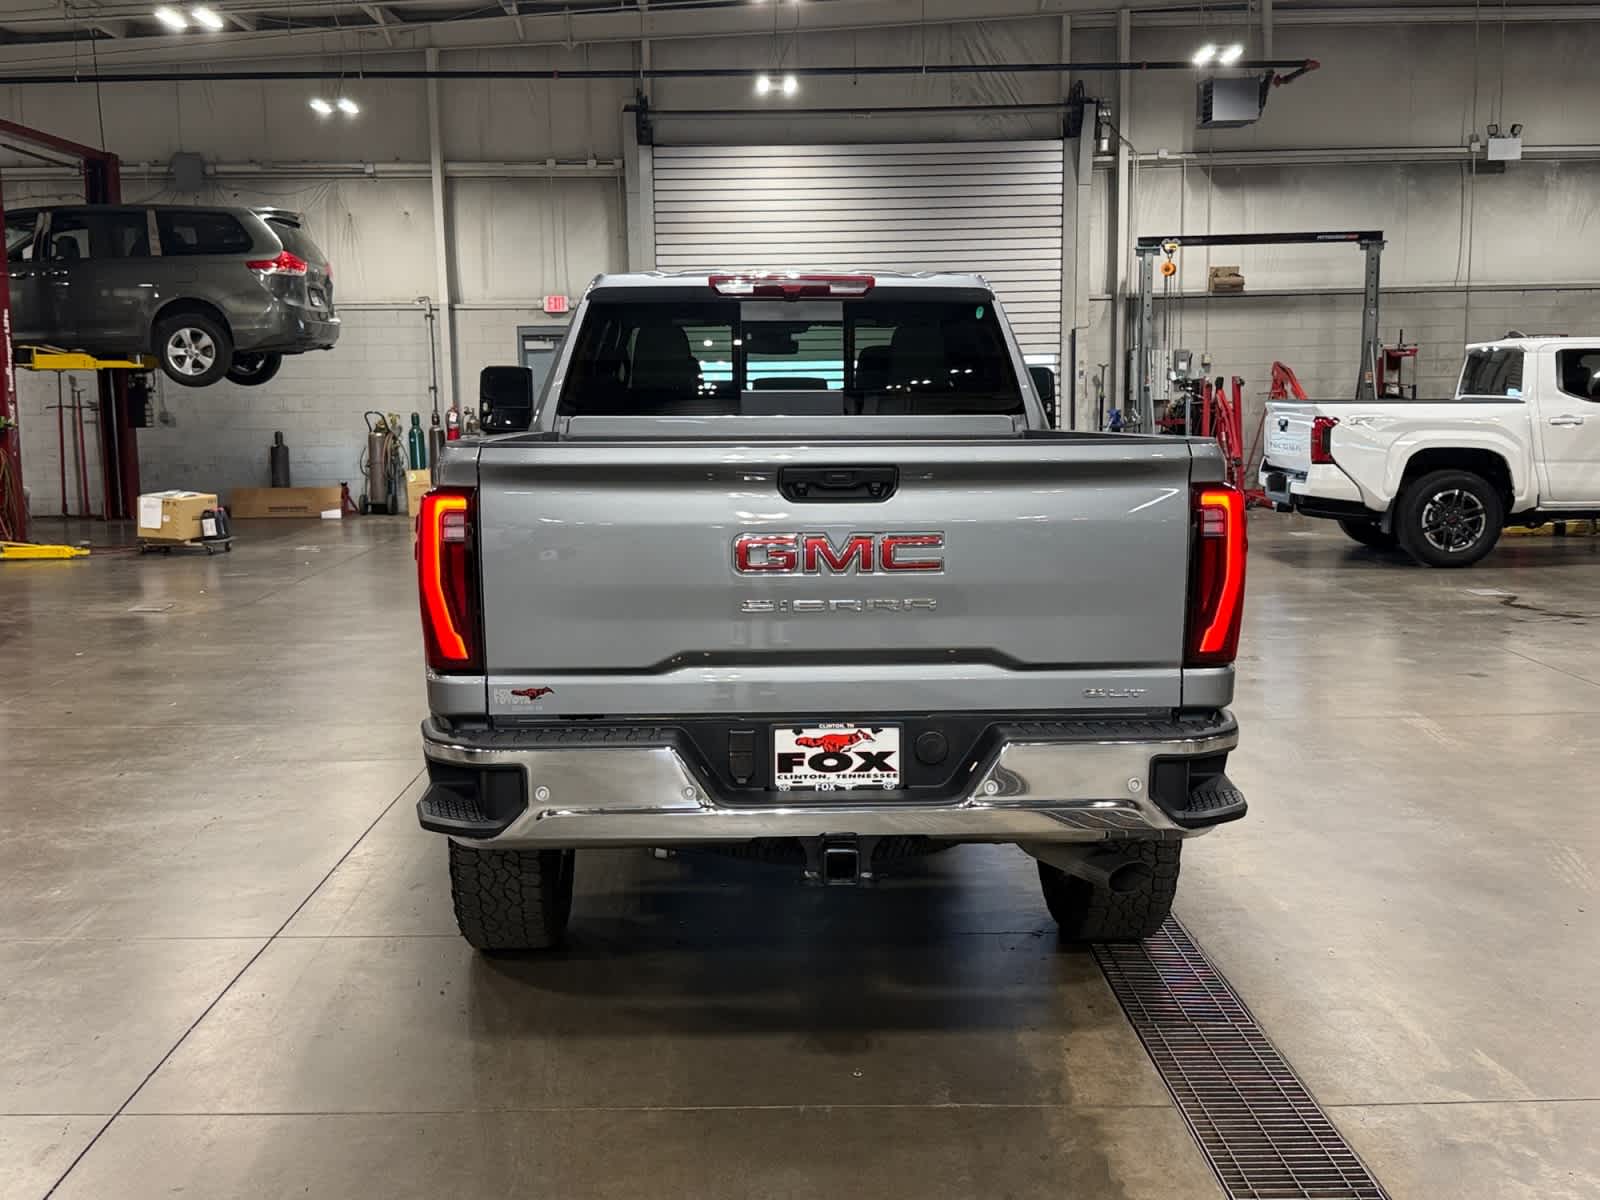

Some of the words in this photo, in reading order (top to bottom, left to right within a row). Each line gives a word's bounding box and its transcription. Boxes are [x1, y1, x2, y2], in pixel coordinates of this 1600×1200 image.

[732, 532, 944, 576] GMC
[777, 751, 897, 773] FOX
[815, 783, 836, 791] FOX
